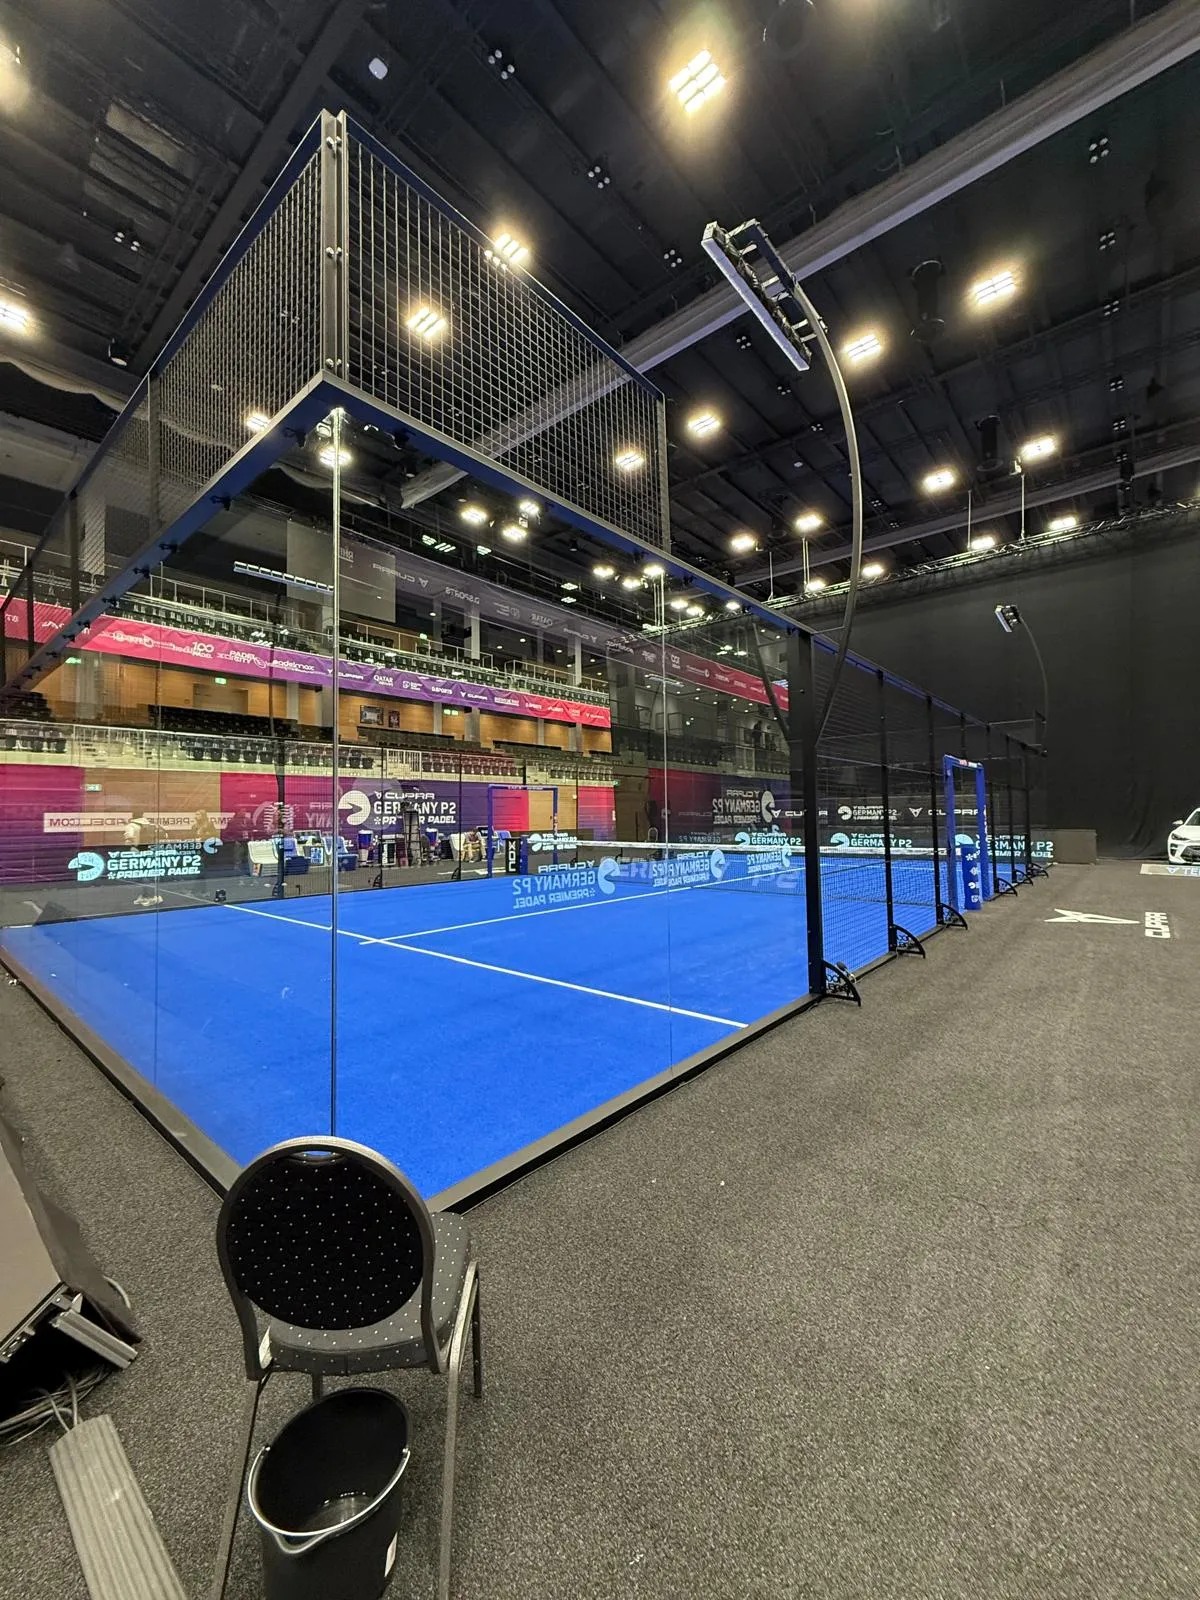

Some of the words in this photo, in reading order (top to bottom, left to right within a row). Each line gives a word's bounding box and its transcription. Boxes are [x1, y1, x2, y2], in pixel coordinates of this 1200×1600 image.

[441, 802, 456, 814] P2
[428, 816, 456, 824] PADEL
[752, 837, 788, 845] GERMANY
[851, 839, 896, 847] GERMAY
[899, 839, 912, 847] P2
[1037, 841, 1053, 851] P2
[107, 856, 181, 871] GERMANY
[182, 855, 201, 867] P2
[168, 867, 201, 876] PADEL
[1145, 912, 1170, 938] CUPRA
